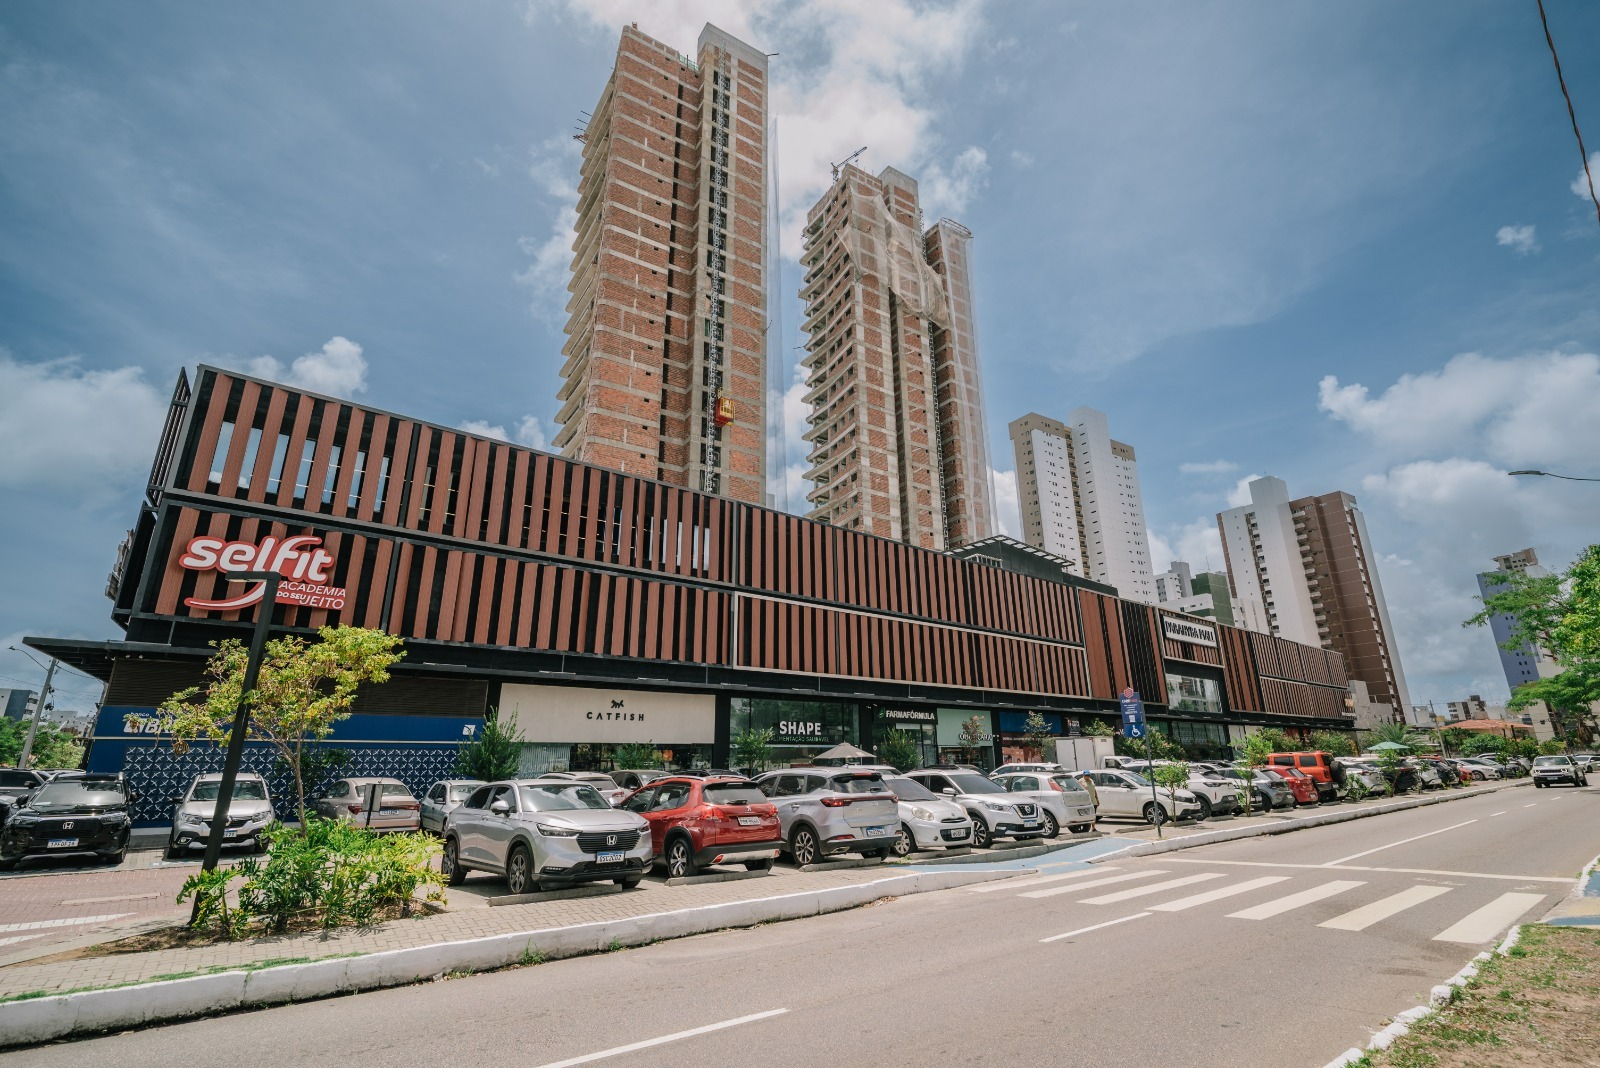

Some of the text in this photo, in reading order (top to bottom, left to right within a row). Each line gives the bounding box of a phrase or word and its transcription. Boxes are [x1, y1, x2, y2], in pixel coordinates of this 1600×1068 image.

[183, 536, 332, 607] selfit
[279, 581, 346, 598] ACADEMIA
[276, 591, 344, 609] DO SEU JEITO
[586, 711, 645, 721] CATFISH
[886, 709, 935, 720] FARMAFÓRMULA
[779, 720, 822, 735] SHAPE
